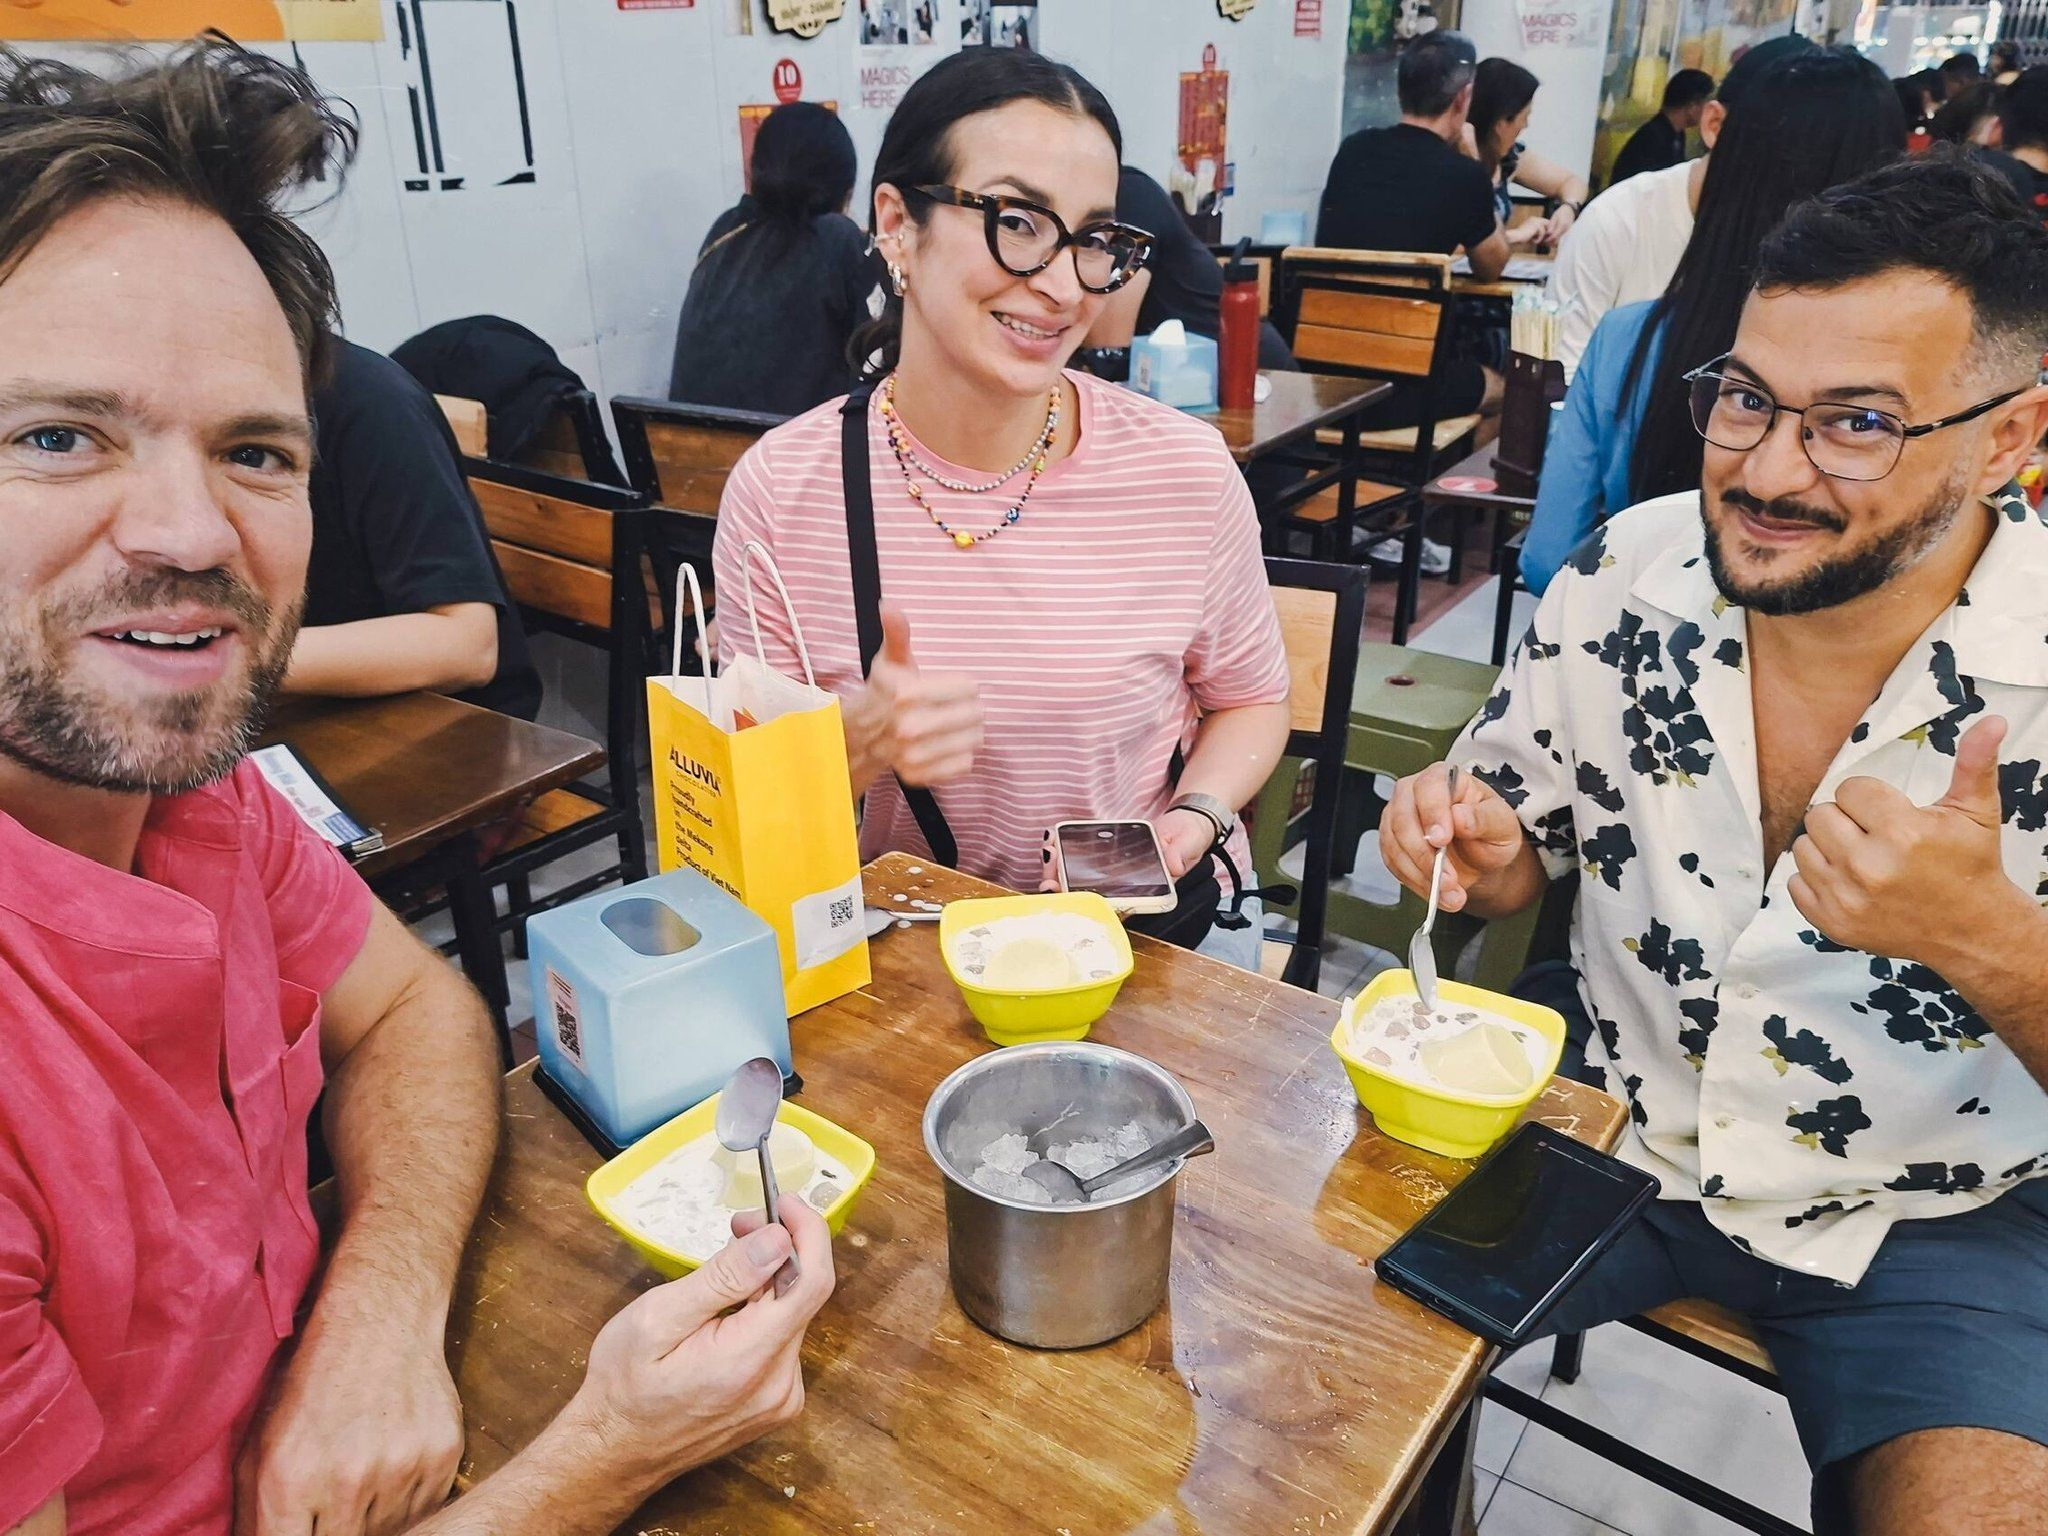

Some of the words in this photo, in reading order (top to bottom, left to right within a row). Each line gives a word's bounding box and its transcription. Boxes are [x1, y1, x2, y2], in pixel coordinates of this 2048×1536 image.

[777, 65, 797, 86] 10
[860, 66, 910, 87] MAGICS
[861, 88, 897, 108] HERE
[686, 828, 713, 855] Mekong
[725, 881, 742, 901] Nam
